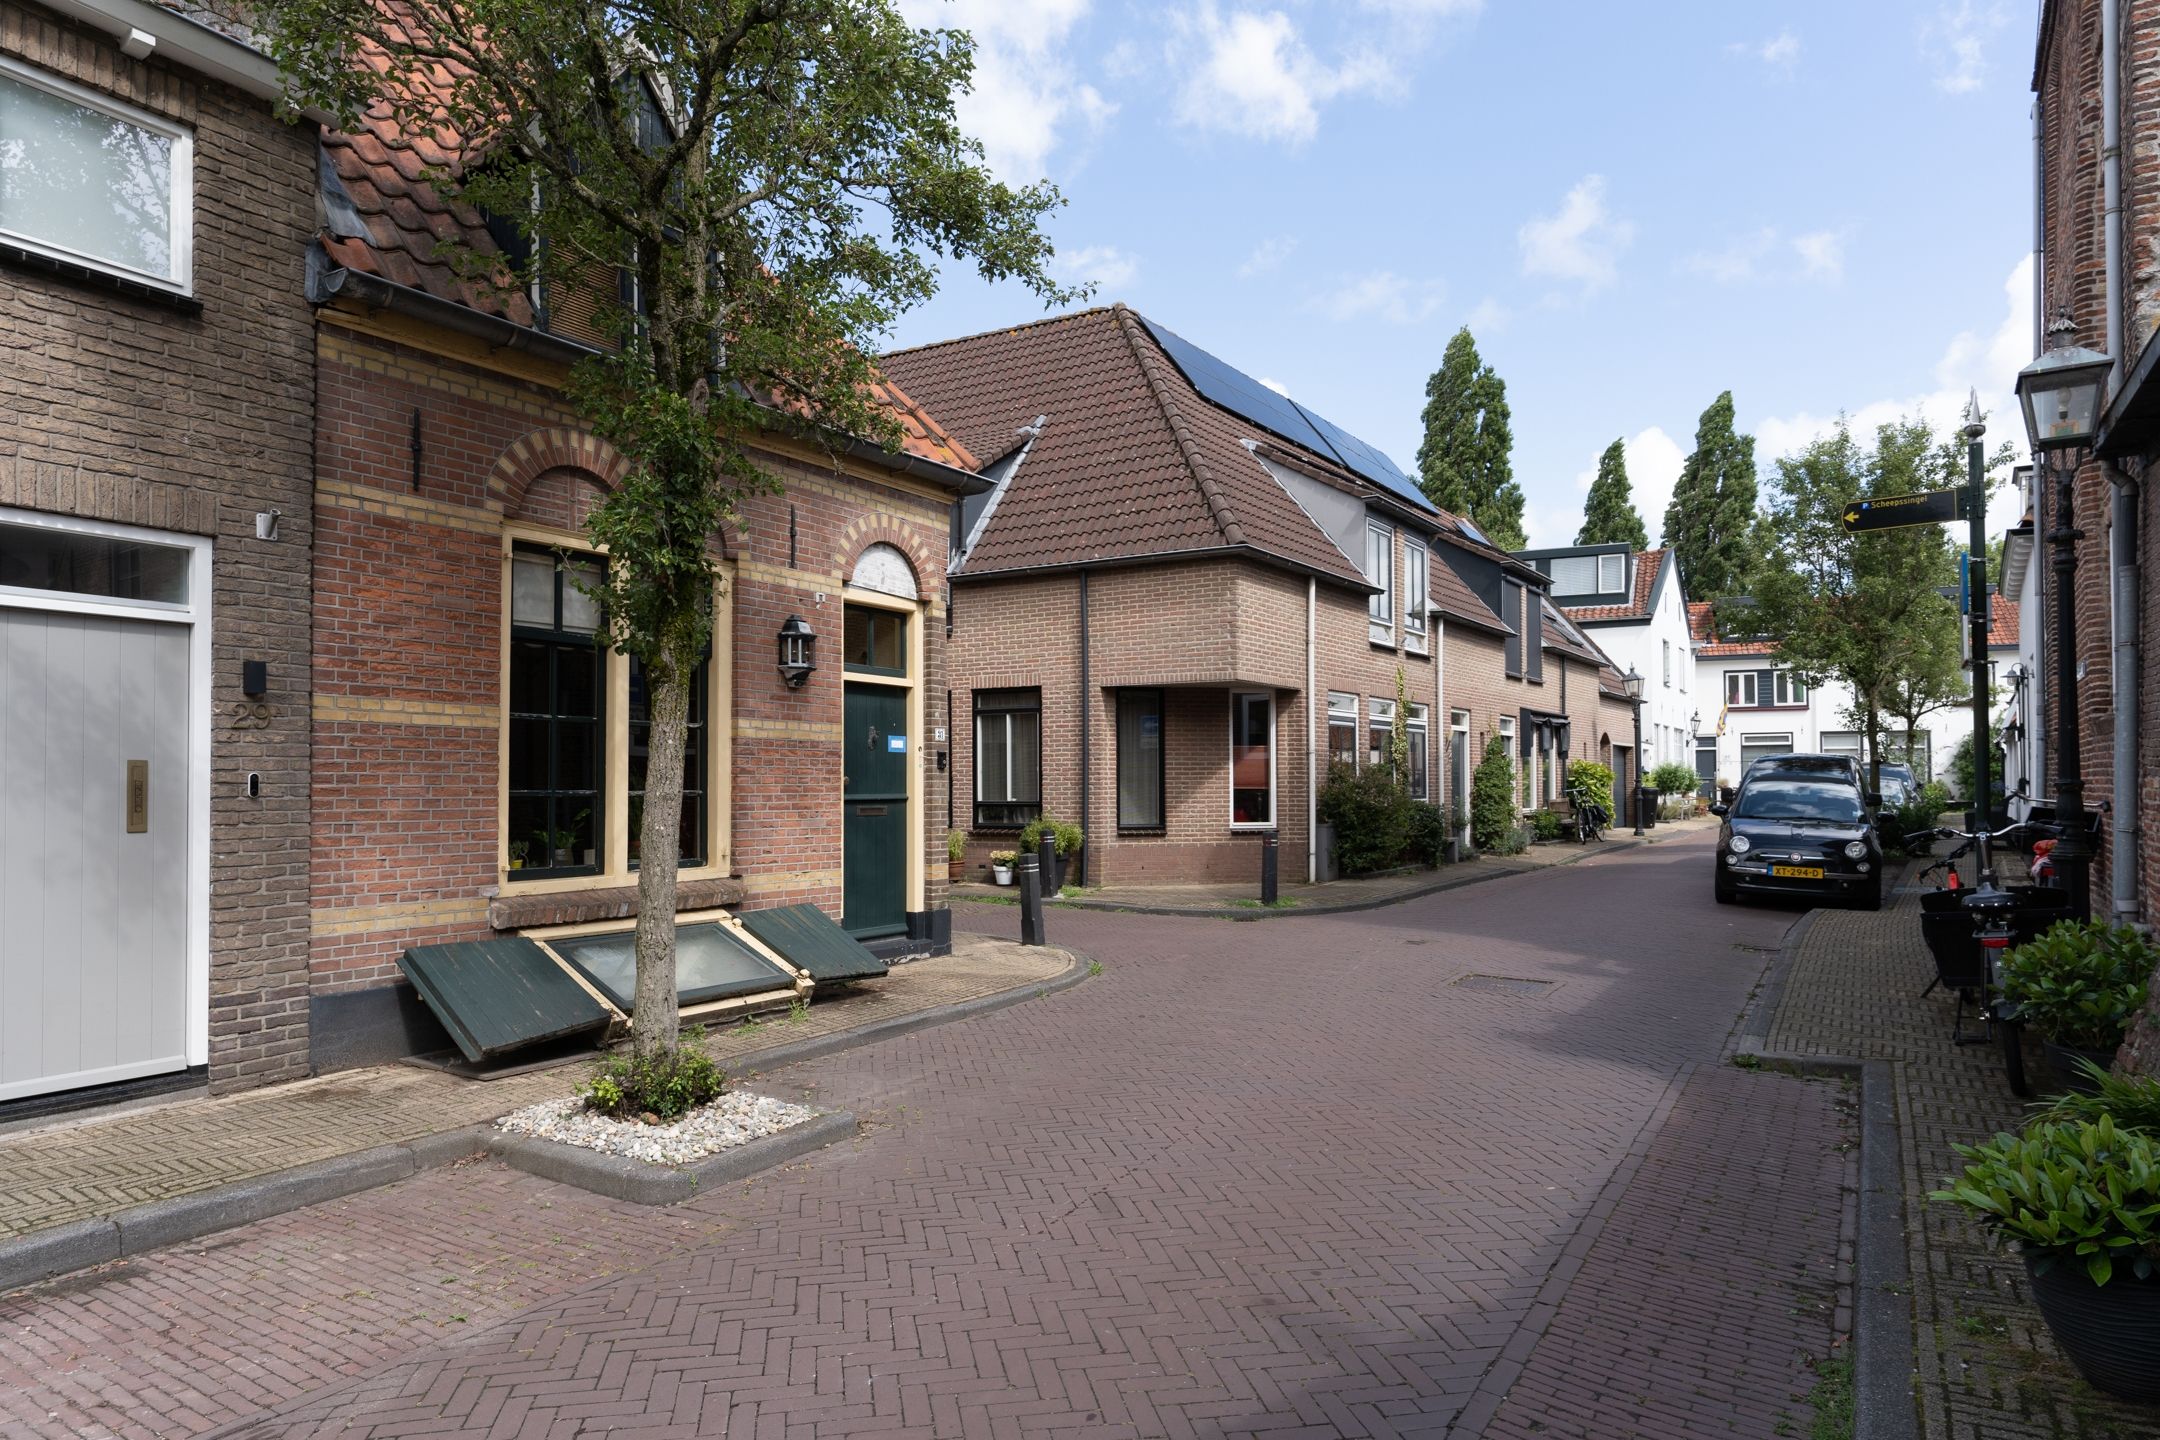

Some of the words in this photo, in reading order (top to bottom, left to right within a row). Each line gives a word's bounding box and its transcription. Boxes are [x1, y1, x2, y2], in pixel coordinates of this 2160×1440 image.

[1871, 495, 1928, 509] Scheepssingel
[231, 703, 271, 730] 29
[1775, 866, 1819, 877] XT-294-D
